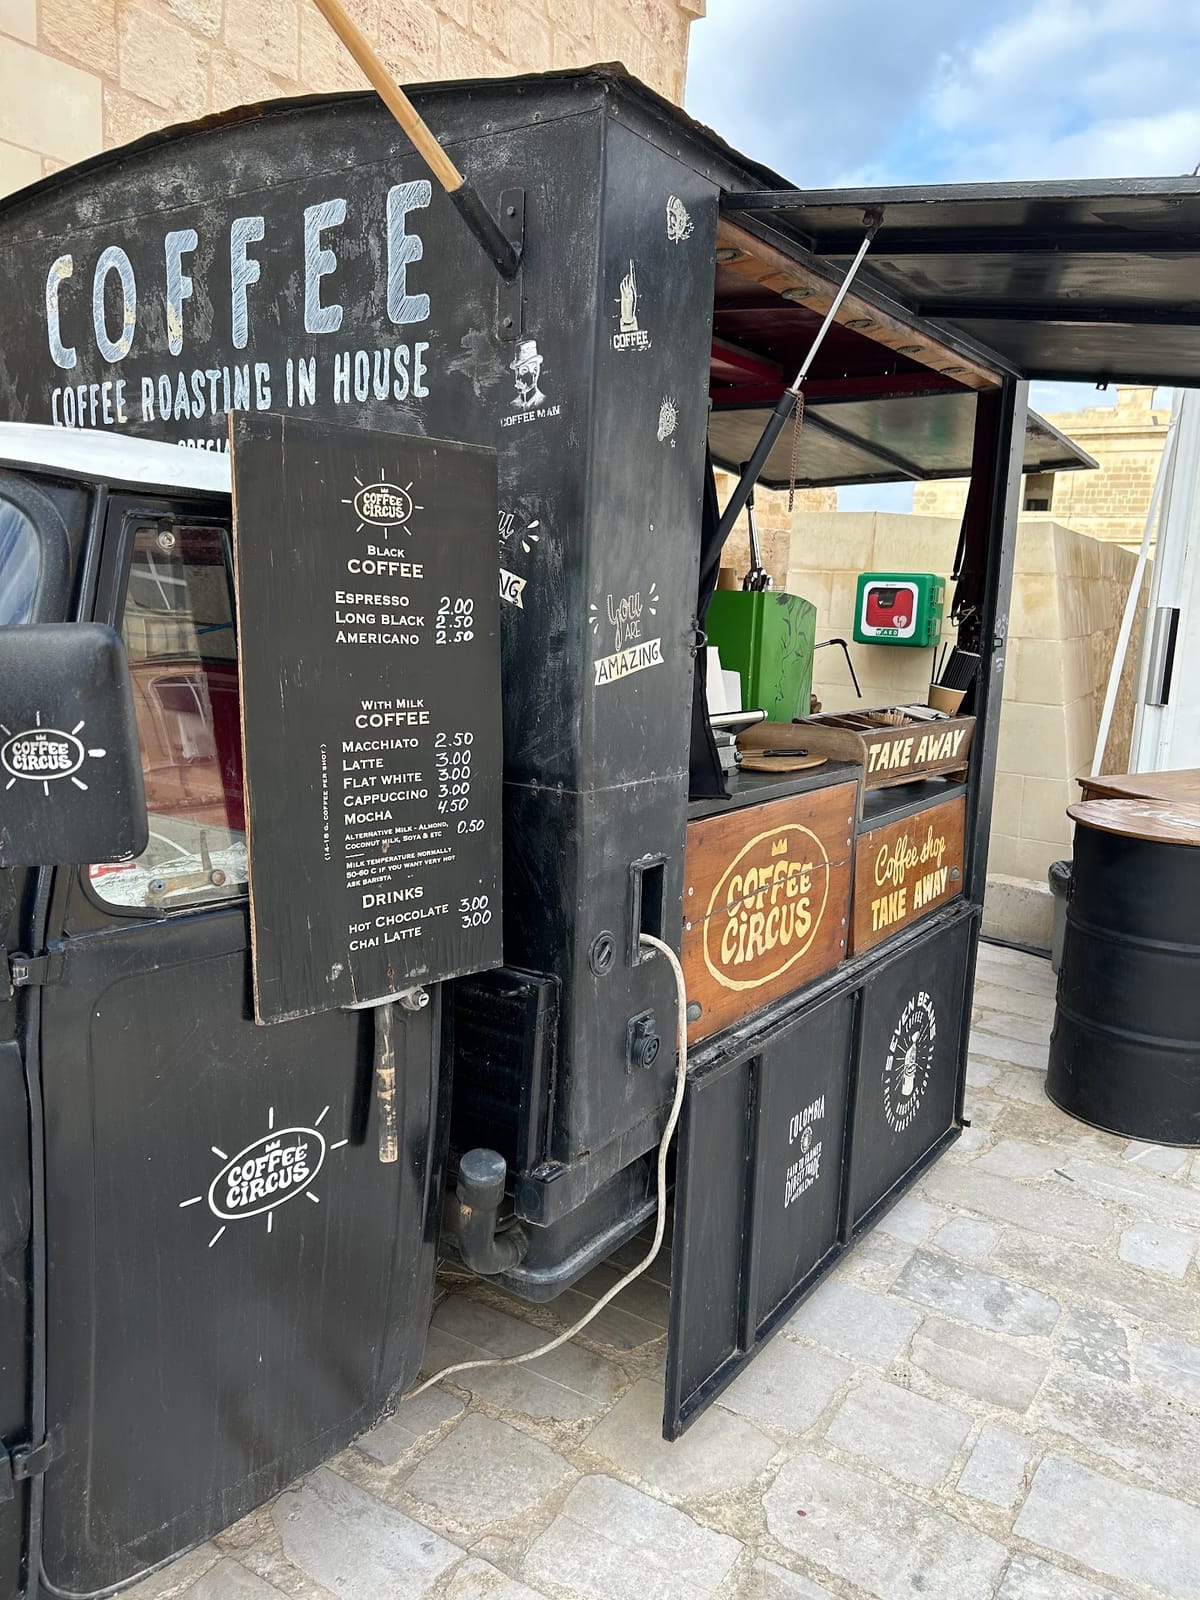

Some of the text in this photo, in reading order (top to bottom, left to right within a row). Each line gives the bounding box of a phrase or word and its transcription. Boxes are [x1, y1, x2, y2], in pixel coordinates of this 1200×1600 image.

[46, 180, 432, 370] COFFEE
[613, 331, 649, 349] COFFEE
[52, 341, 430, 428] COFFEE ROASTING IN HOUSE
[500, 404, 561, 428] COFFEE MAN
[362, 492, 403, 507] COFFEE
[367, 544, 405, 559] BLACK
[347, 558, 424, 579] COFFEE
[335, 590, 474, 615] ESPRESSO 2.00
[335, 610, 474, 630] LONG BLACK 2.50
[624, 620, 642, 640] ARE
[335, 630, 474, 645] AMERICANO 2.50
[597, 642, 660, 684] AMAZING
[361, 698, 425, 711] WITH MILK
[355, 710, 431, 729] COFFEE
[12, 740, 69, 755] COFFEE
[342, 731, 474, 753] MACCHIATO 2.50
[868, 729, 966, 773] TAKE AWAY
[342, 749, 472, 772] LATTE 3.00
[343, 765, 471, 789] FLAT WHITE 3.00
[343, 781, 470, 807] CAPPUCCINO 3.00
[344, 797, 469, 826] MOCHA 4.50
[345, 828, 393, 842] ALTERNATIVE
[395, 825, 413, 834] MILK
[418, 821, 449, 831] ALMOND,
[457, 819, 485, 834] 0.50
[345, 839, 381, 851] COCONUT
[403, 833, 422, 843] SOYA
[430, 830, 443, 839] ETC
[346, 847, 453, 870] MILK TEMPERATURE NORMALLY
[346, 868, 370, 879] 50-60
[370, 867, 377, 875] C
[388, 863, 402, 871] YOU
[403, 860, 423, 869] WANT
[424, 857, 441, 866] VERY
[443, 854, 456, 863] HOT
[874, 825, 946, 887] Coffee shop
[346, 874, 392, 889] ASK BARISTA
[727, 859, 813, 917] COFFEE
[362, 886, 424, 909] DRINKS
[871, 865, 949, 932] TAKE AWAY
[348, 895, 489, 934] HOT CHOCOLATE 3.00
[349, 909, 492, 952] CHAI LATTE 3.00
[917, 991, 937, 1041] BEANS
[789, 1094, 825, 1145] COLOMBIA
[227, 1142, 308, 1187] COFFEE
